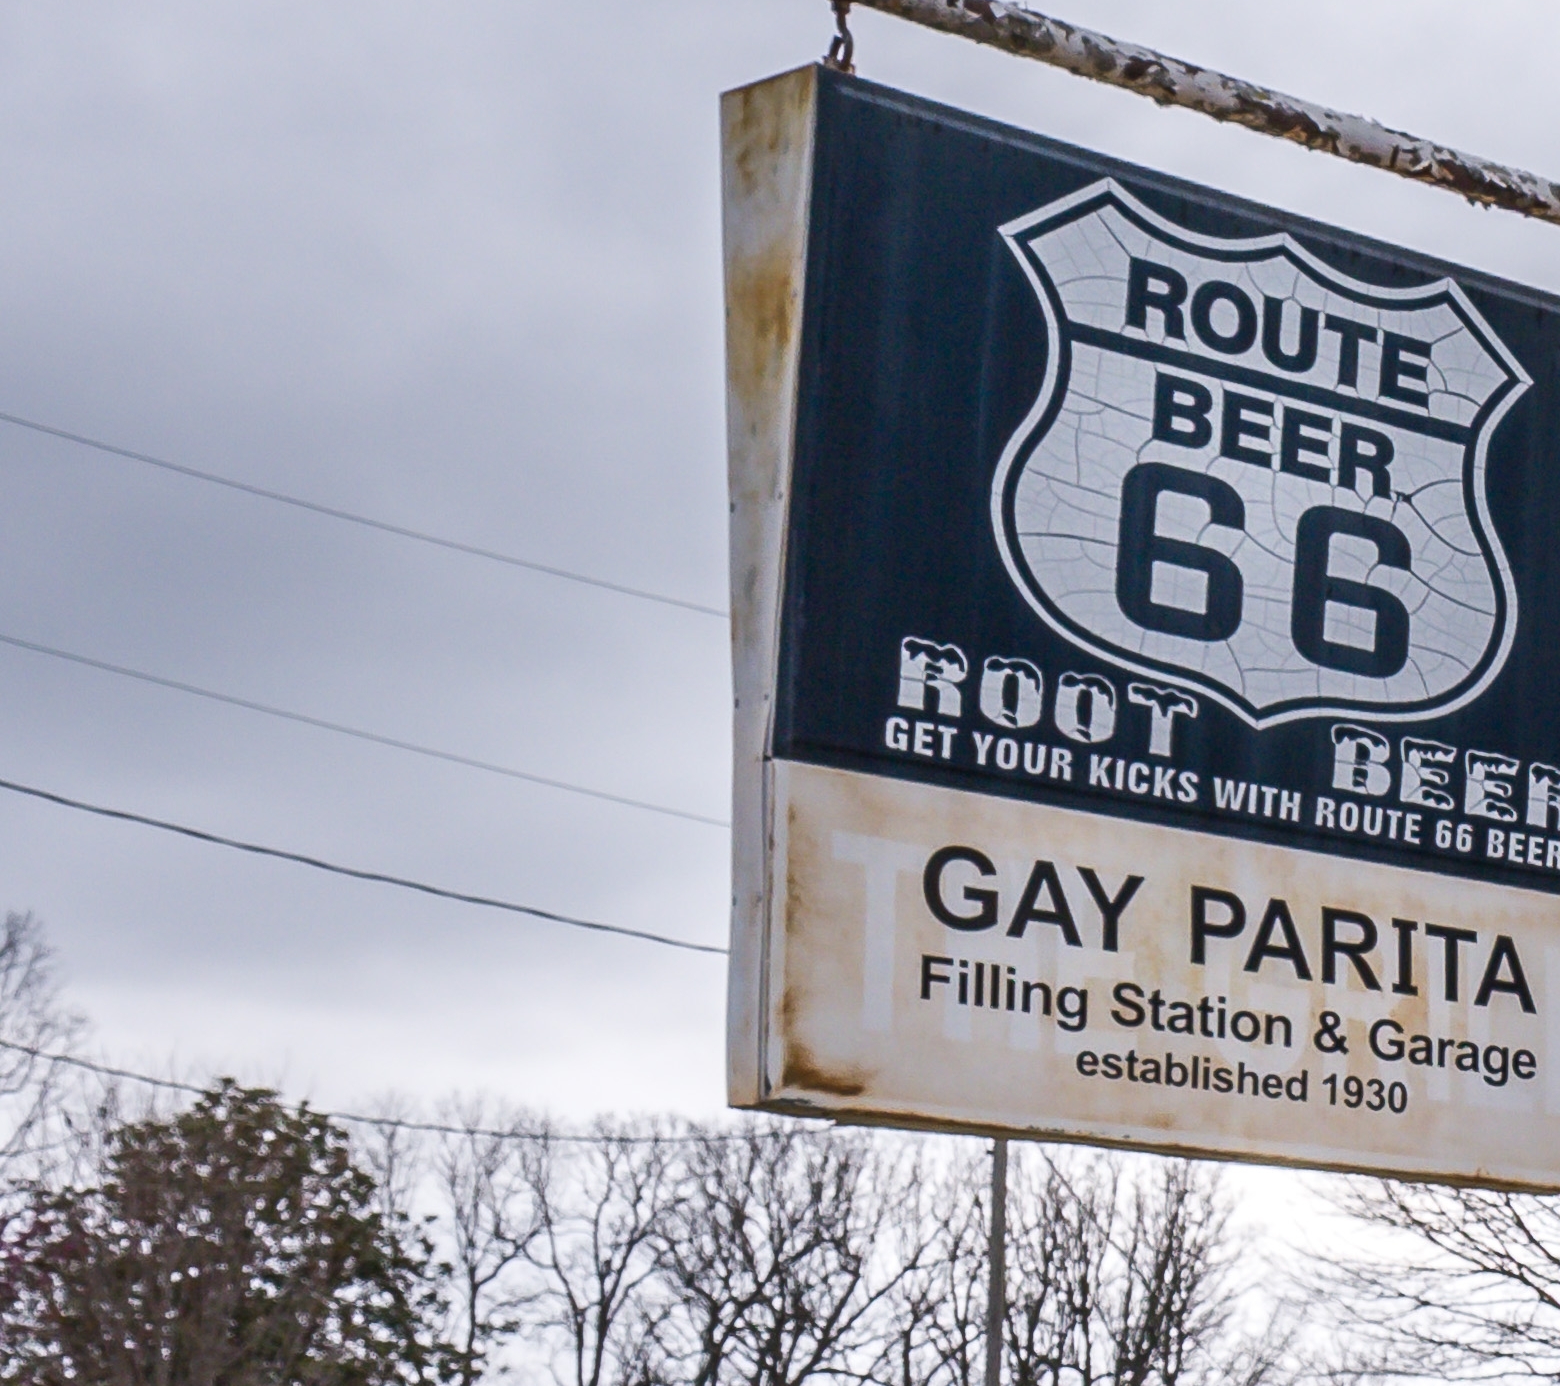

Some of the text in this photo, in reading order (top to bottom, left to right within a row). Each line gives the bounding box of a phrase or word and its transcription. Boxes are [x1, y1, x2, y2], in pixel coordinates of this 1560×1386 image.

[1125, 255, 1433, 411] ROUTE
[1153, 367, 1396, 498] BEER
[1114, 460, 1412, 680] 66
[896, 635, 1199, 758] ROOT
[885, 715, 952, 758] GET
[972, 732, 1073, 782] YOUR
[1088, 754, 1199, 803] KICKS
[1213, 777, 1302, 823] WITH
[1315, 796, 1422, 845] ROUTE
[1435, 821, 1474, 853] 66
[922, 845, 1538, 1015] GAY PARITA
[919, 954, 1538, 1086] Filling Station & Garage
[1075, 1049, 1408, 1115] established 1930
